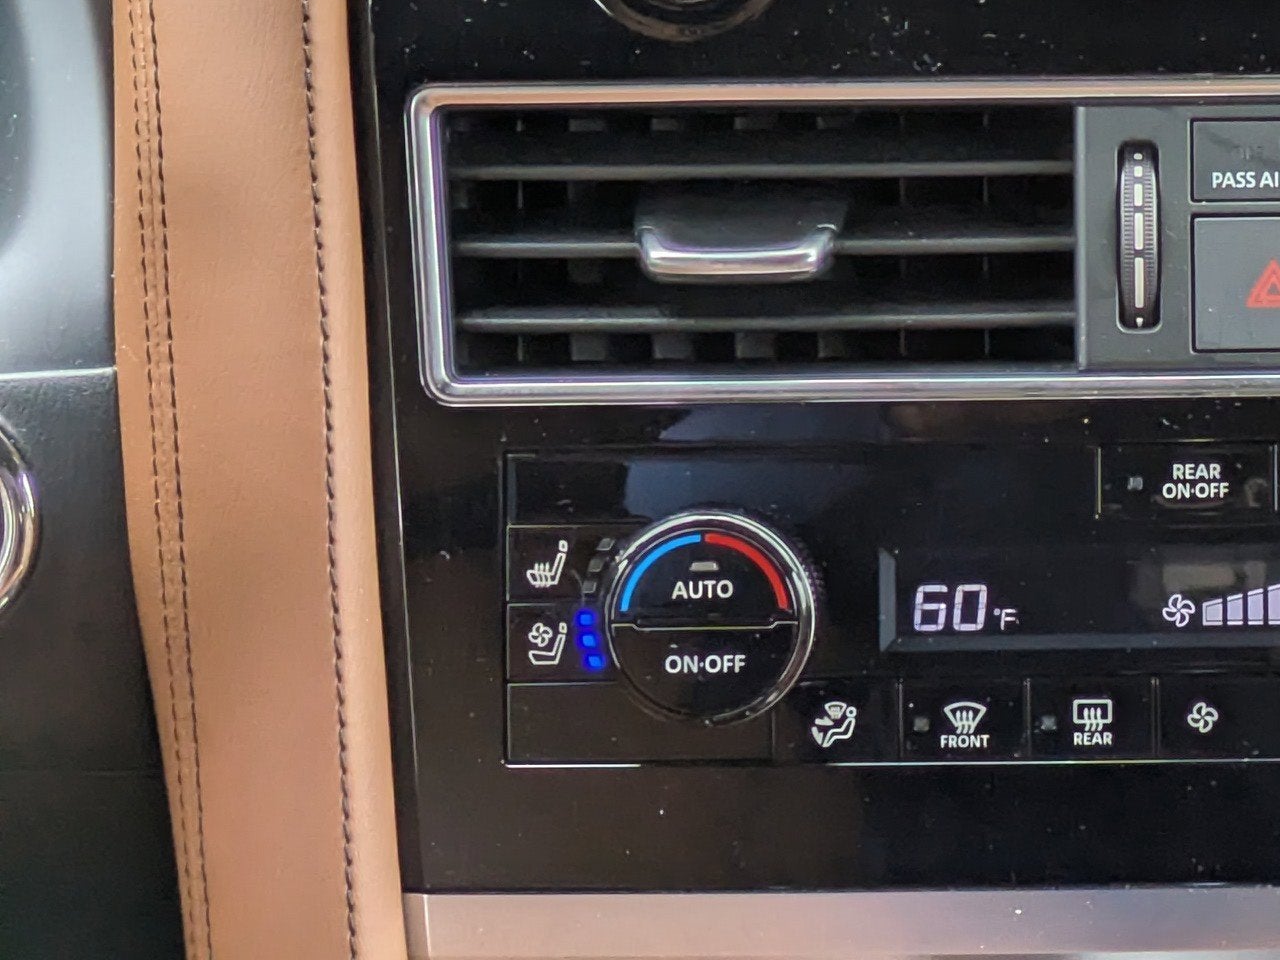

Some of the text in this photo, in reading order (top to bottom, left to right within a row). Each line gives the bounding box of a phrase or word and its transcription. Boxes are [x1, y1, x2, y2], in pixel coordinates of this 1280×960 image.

[1212, 171, 1256, 188] PASS
[1172, 463, 1221, 480] REAR
[671, 580, 733, 600] AUTO
[940, 735, 990, 748] FRONT
[1073, 732, 1113, 746] REAR
